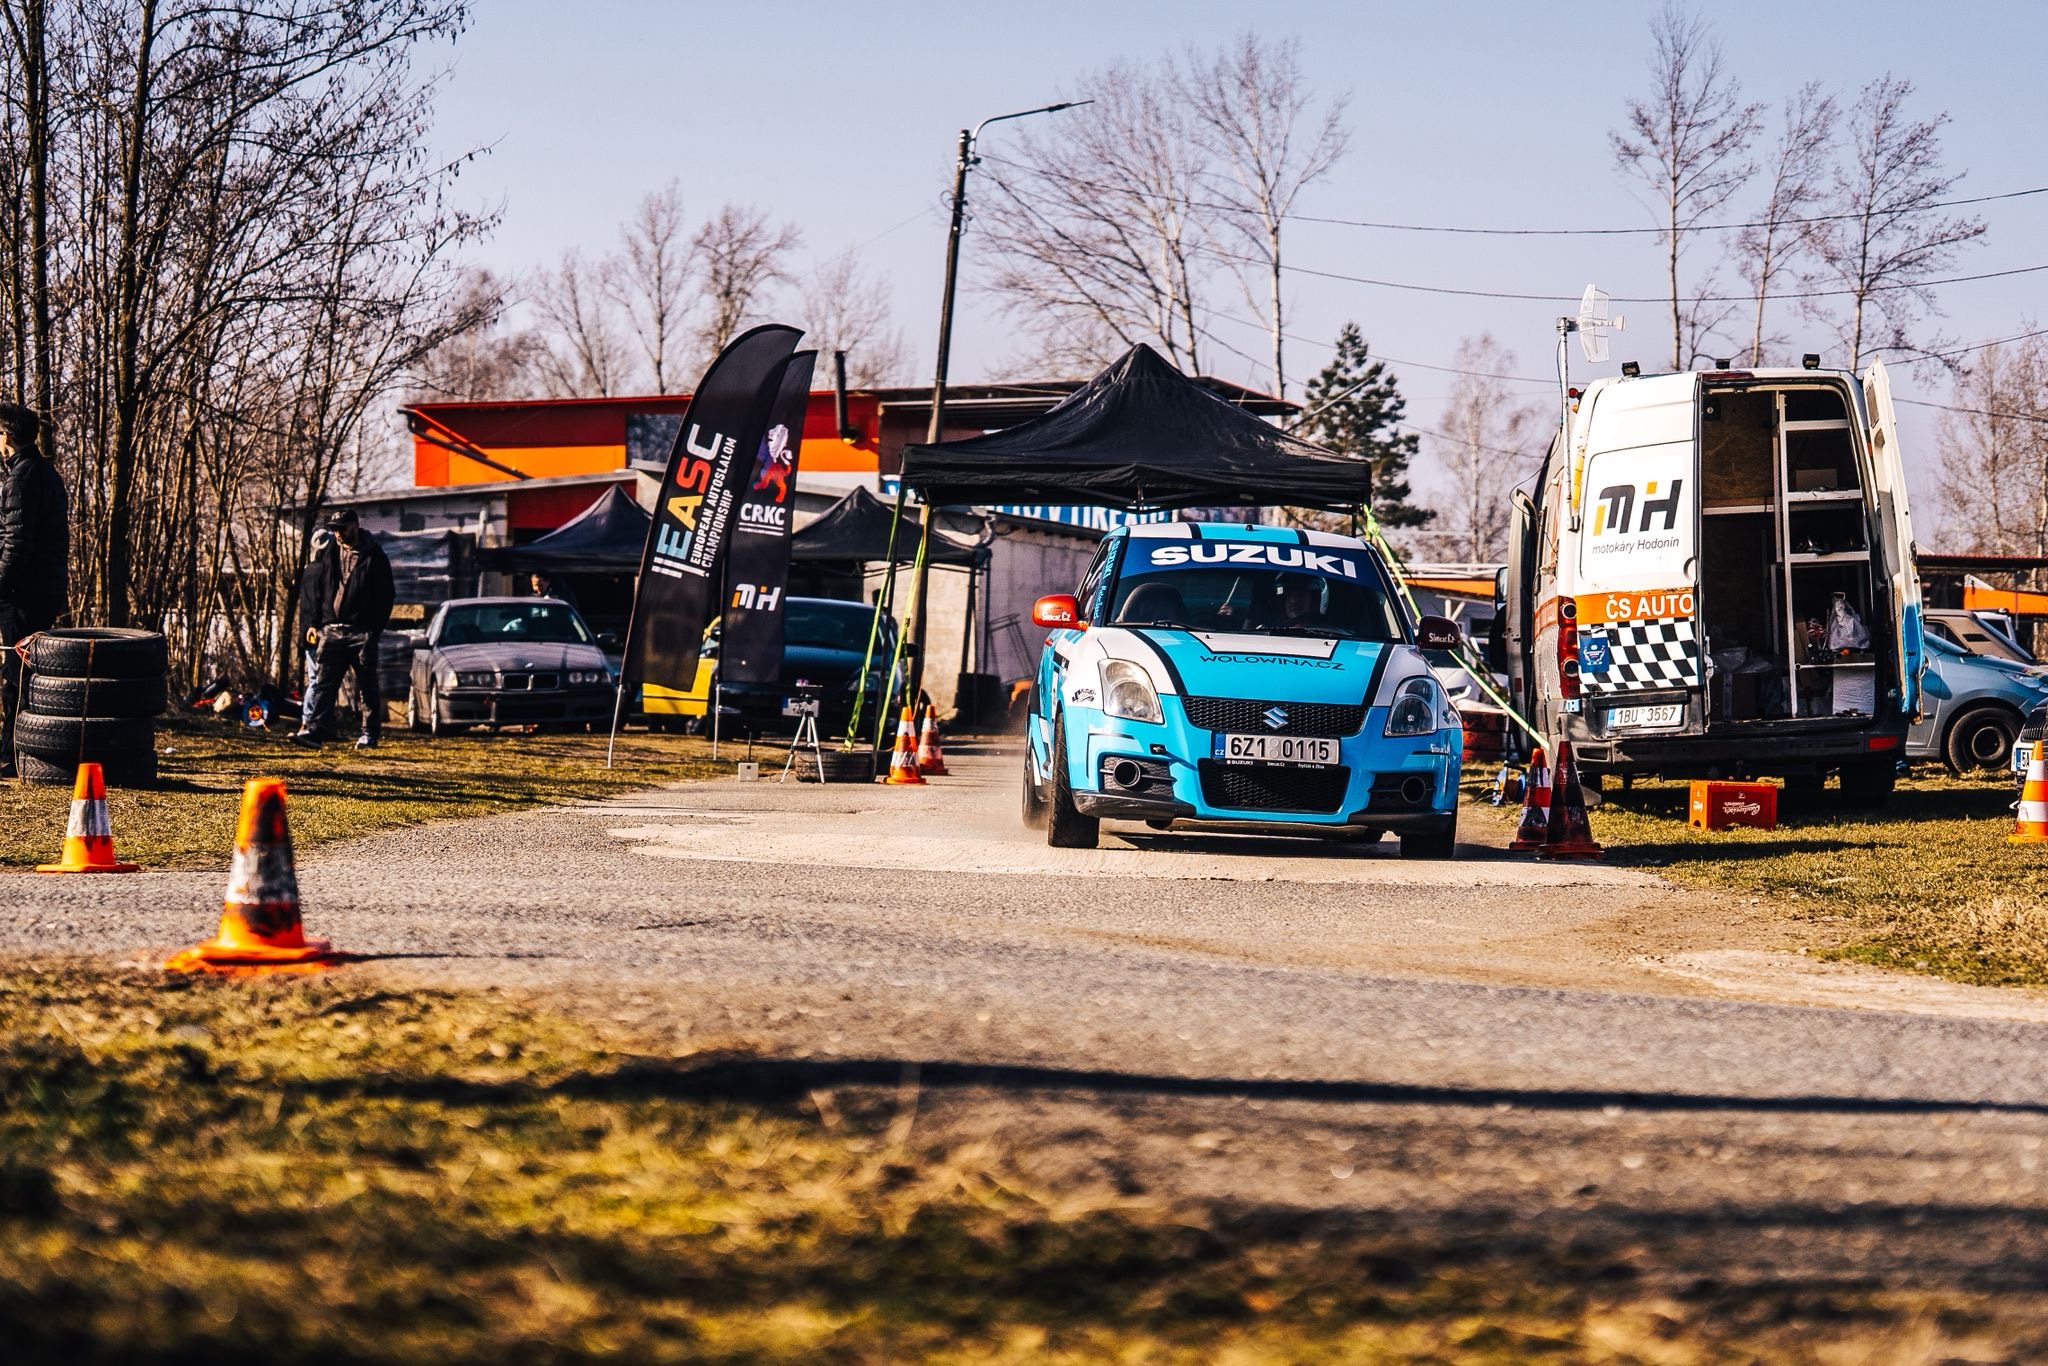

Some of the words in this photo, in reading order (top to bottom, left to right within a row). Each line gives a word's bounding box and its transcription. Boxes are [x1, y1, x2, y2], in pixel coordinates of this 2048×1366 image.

[655, 423, 723, 560] EASC
[690, 508, 714, 565] EUROPEAN
[707, 437, 737, 507] AUTOSLALOM
[740, 502, 786, 525] CRKC
[701, 489, 734, 567] CHAMPIONSHIP
[1150, 544, 1357, 578] SUZUKI
[1605, 594, 1631, 619] ČS
[1636, 593, 1694, 617] AUTO
[1200, 655, 1345, 671] WOLOWINA.CZ
[1618, 708, 1638, 725] 1BU
[1646, 706, 1676, 722] 3567
[1230, 737, 1266, 758] 6Z1
[1282, 739, 1330, 760] 0115
